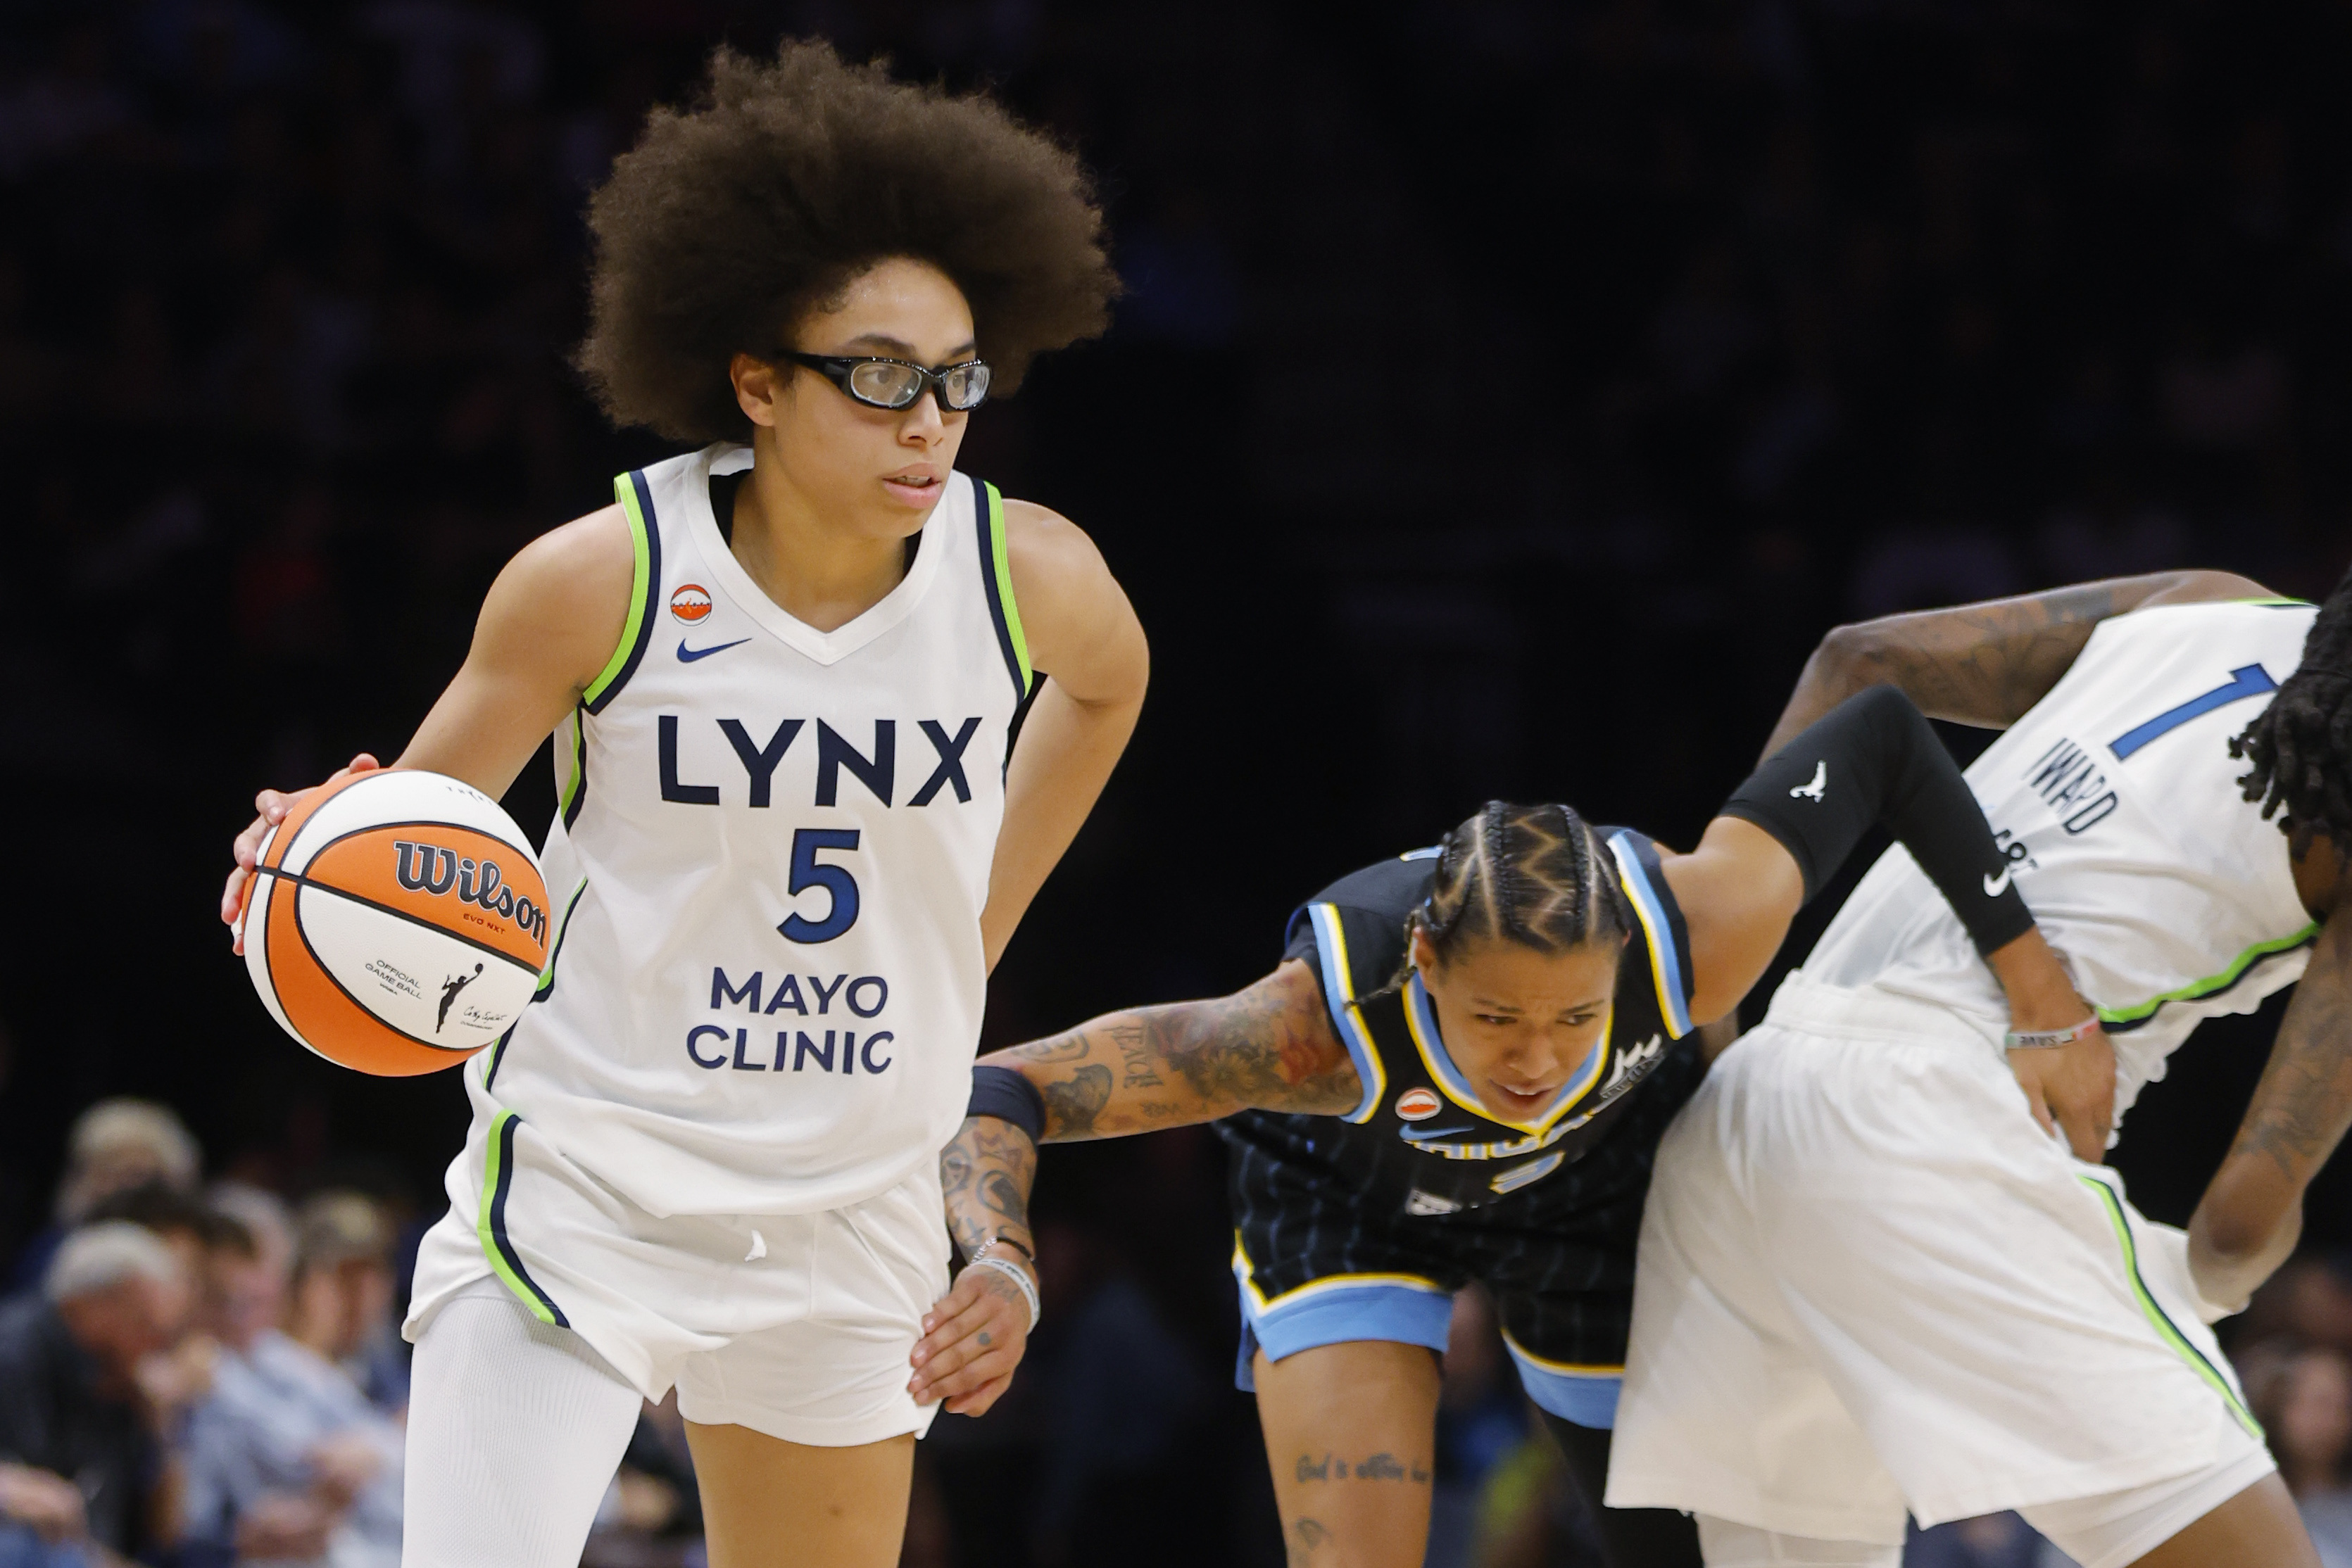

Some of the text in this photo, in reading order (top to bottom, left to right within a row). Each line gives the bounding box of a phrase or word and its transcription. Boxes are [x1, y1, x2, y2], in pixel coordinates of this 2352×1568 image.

[2107, 663, 2279, 762] 1
[658, 715, 983, 808] LYNX
[394, 840, 546, 950] Wilson
[776, 828, 861, 944] 5
[463, 913, 506, 935] EVO NXT
[365, 963, 422, 1000] GAME BALL
[376, 959, 420, 989] OFFICIAL
[710, 967, 888, 1018] MAYO
[686, 1025, 895, 1075] CLINIC
